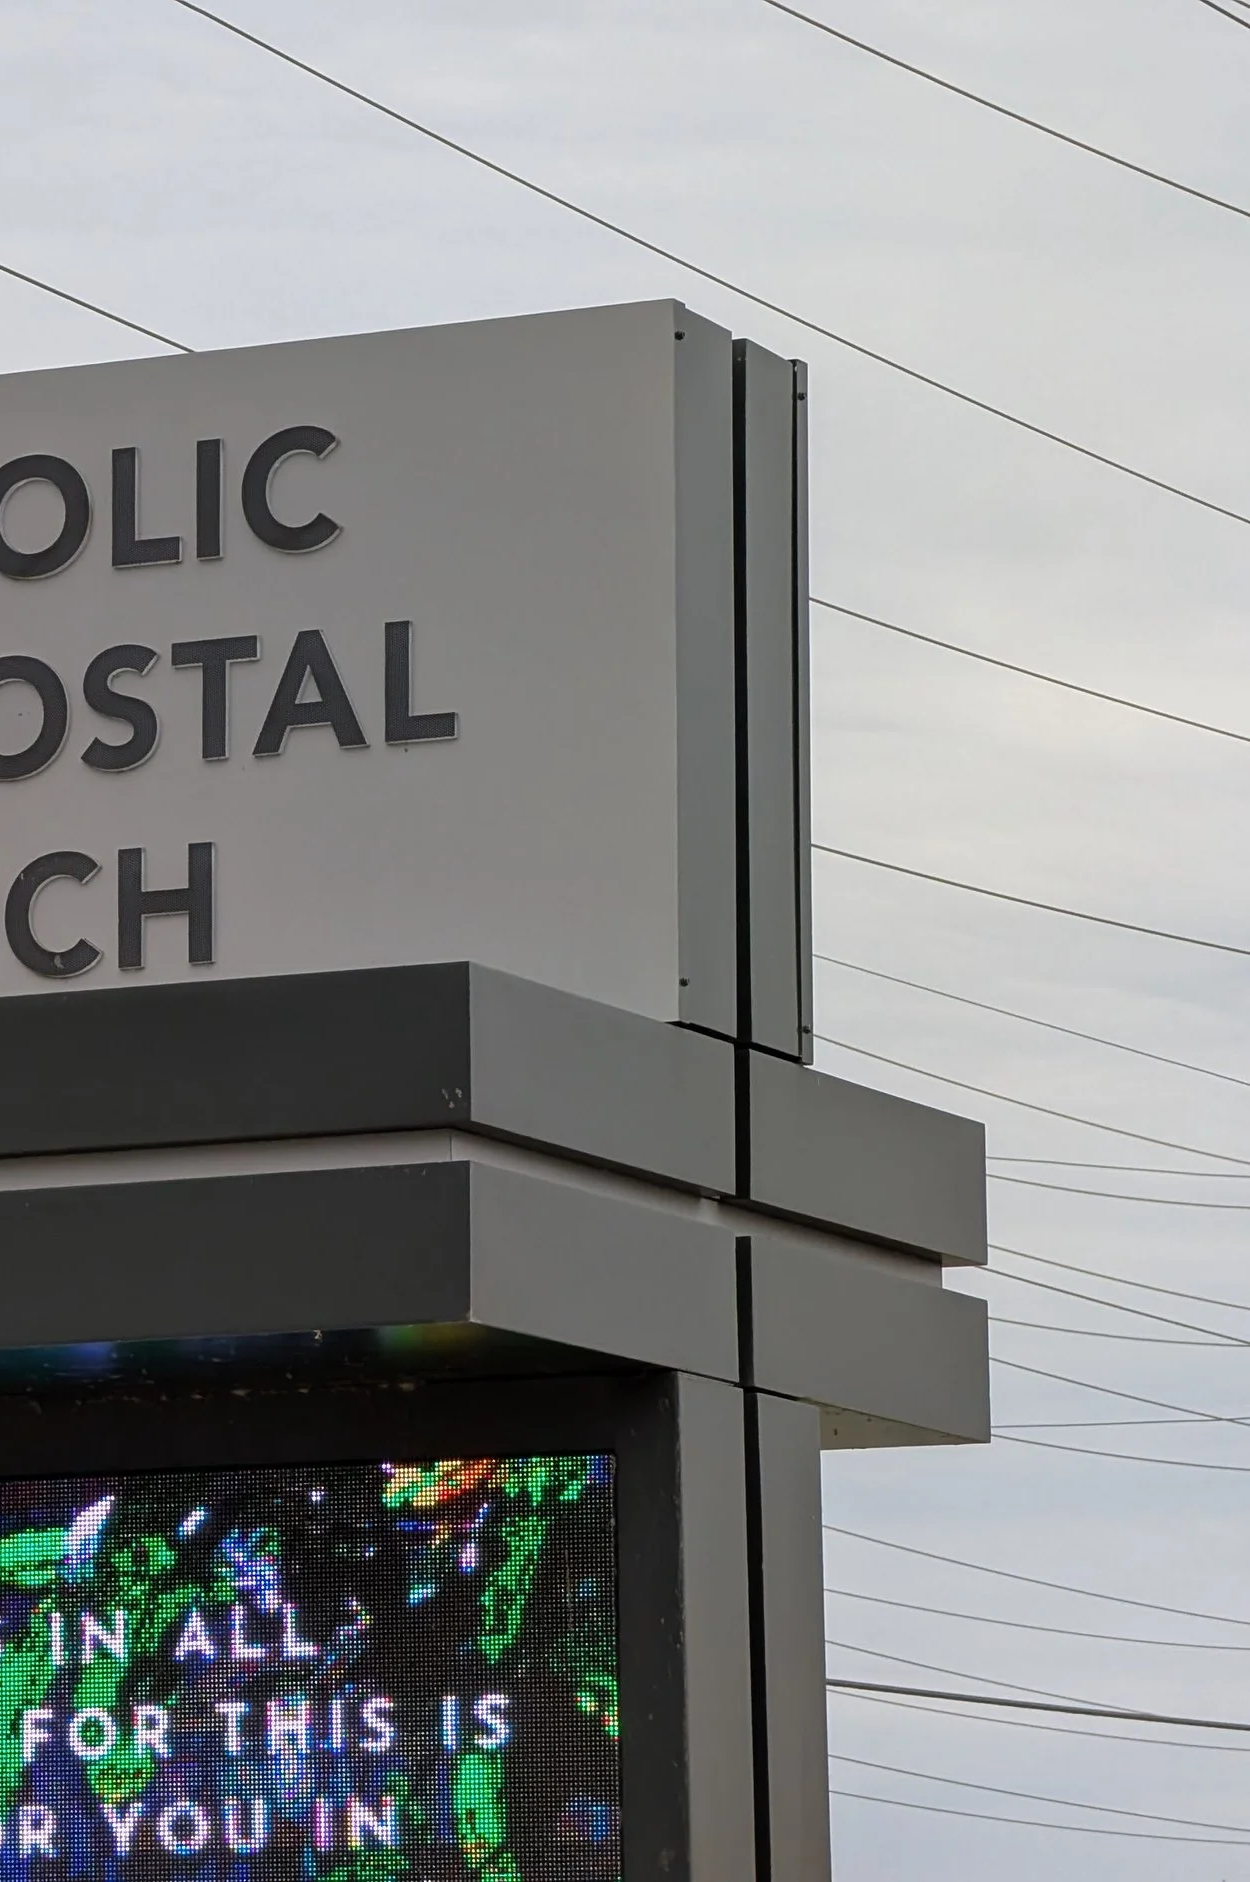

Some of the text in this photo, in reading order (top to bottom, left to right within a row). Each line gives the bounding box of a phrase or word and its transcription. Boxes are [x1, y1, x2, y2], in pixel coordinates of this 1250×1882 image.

[51, 1608, 128, 1666] IN
[174, 1603, 319, 1661] ALL
[22, 1704, 171, 1762] FOR
[215, 1696, 395, 1756] THIS
[442, 1694, 512, 1751] IS
[108, 1797, 269, 1855] YOU
[315, 1795, 398, 1850] IN
